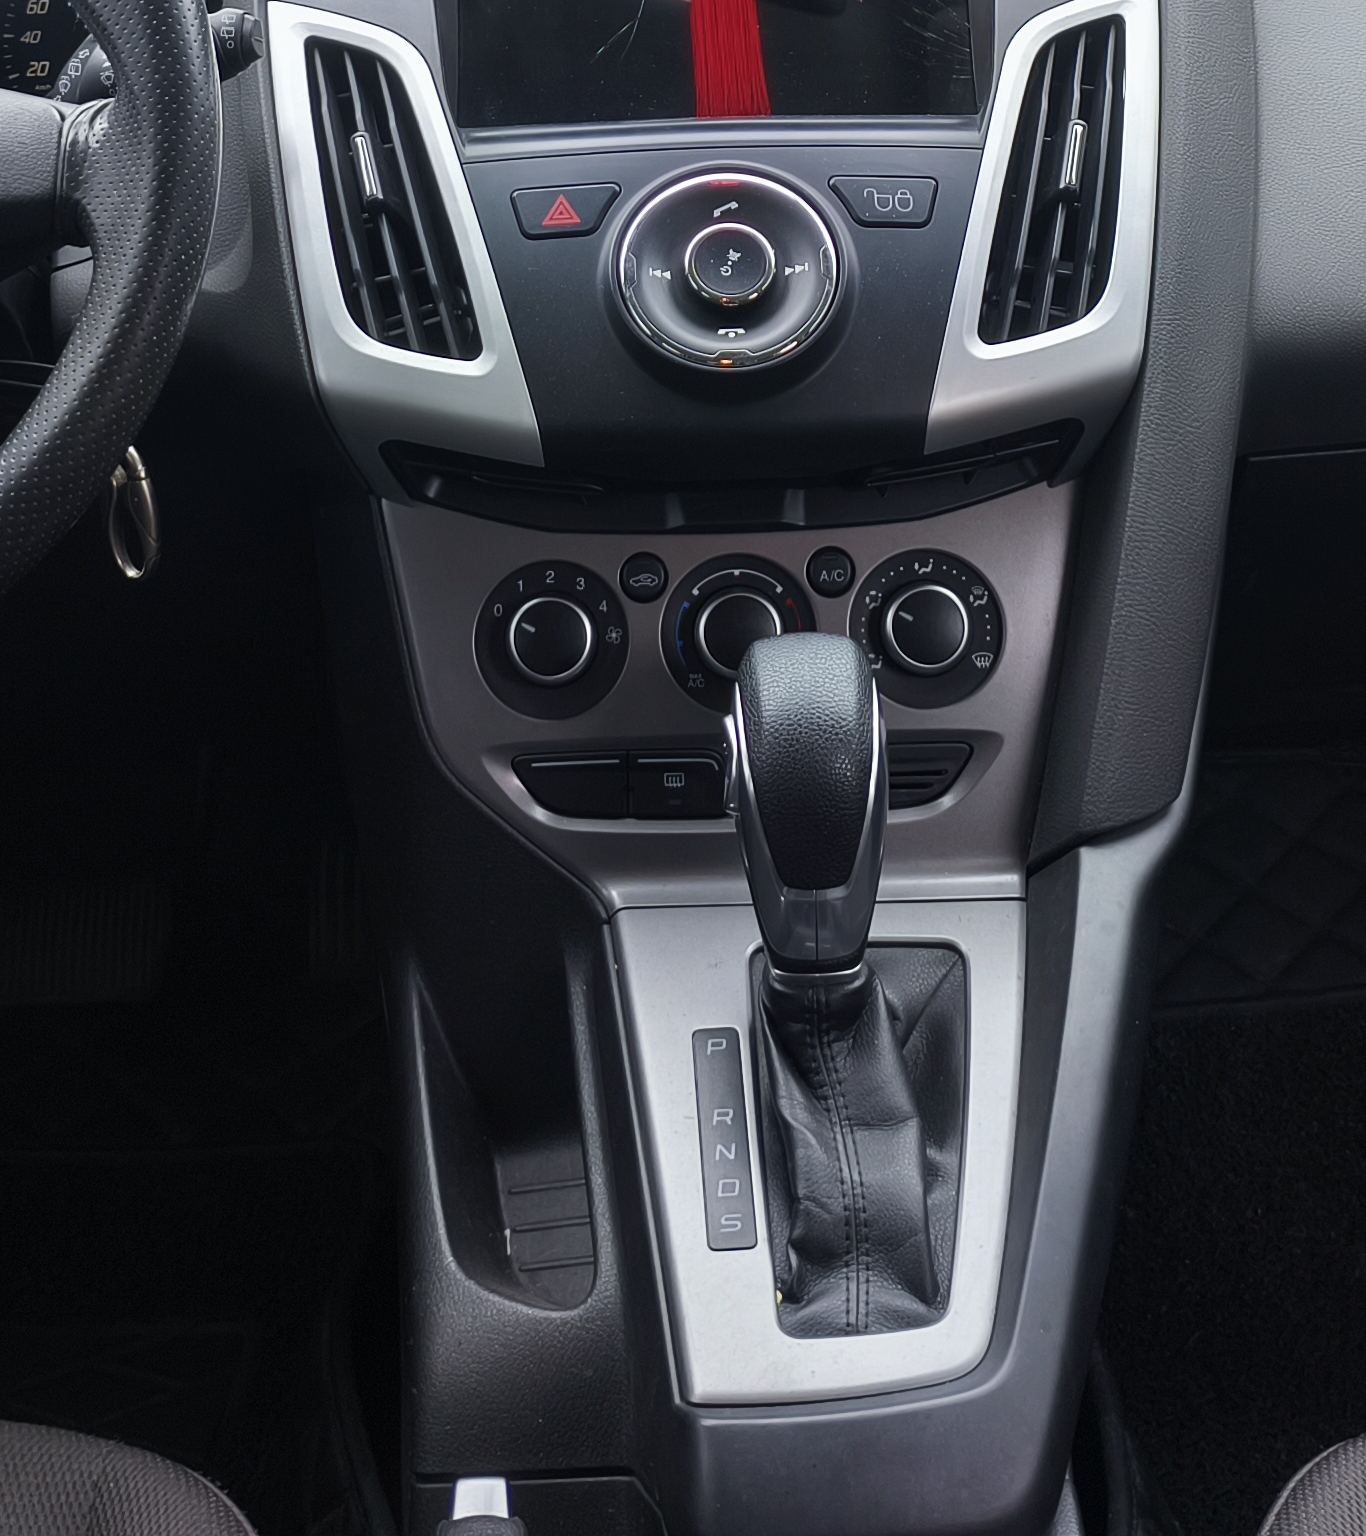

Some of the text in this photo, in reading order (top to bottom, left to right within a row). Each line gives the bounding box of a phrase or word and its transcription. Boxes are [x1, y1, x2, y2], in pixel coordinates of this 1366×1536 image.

[26, 0, 49, 14] 60
[20, 30, 42, 44] 40
[26, 61, 50, 76] 20
[545, 570, 555, 583] 2
[819, 569, 845, 582] A/C
[576, 577, 586, 590] 3
[493, 603, 503, 616] 0
[599, 599, 608, 613] 4
[687, 678, 705, 689] A/C
[706, 1038, 727, 1056] P
[712, 1108, 734, 1126] R
[715, 1142, 736, 1161] N
[717, 1178, 740, 1197] D
[719, 1213, 742, 1233] S
